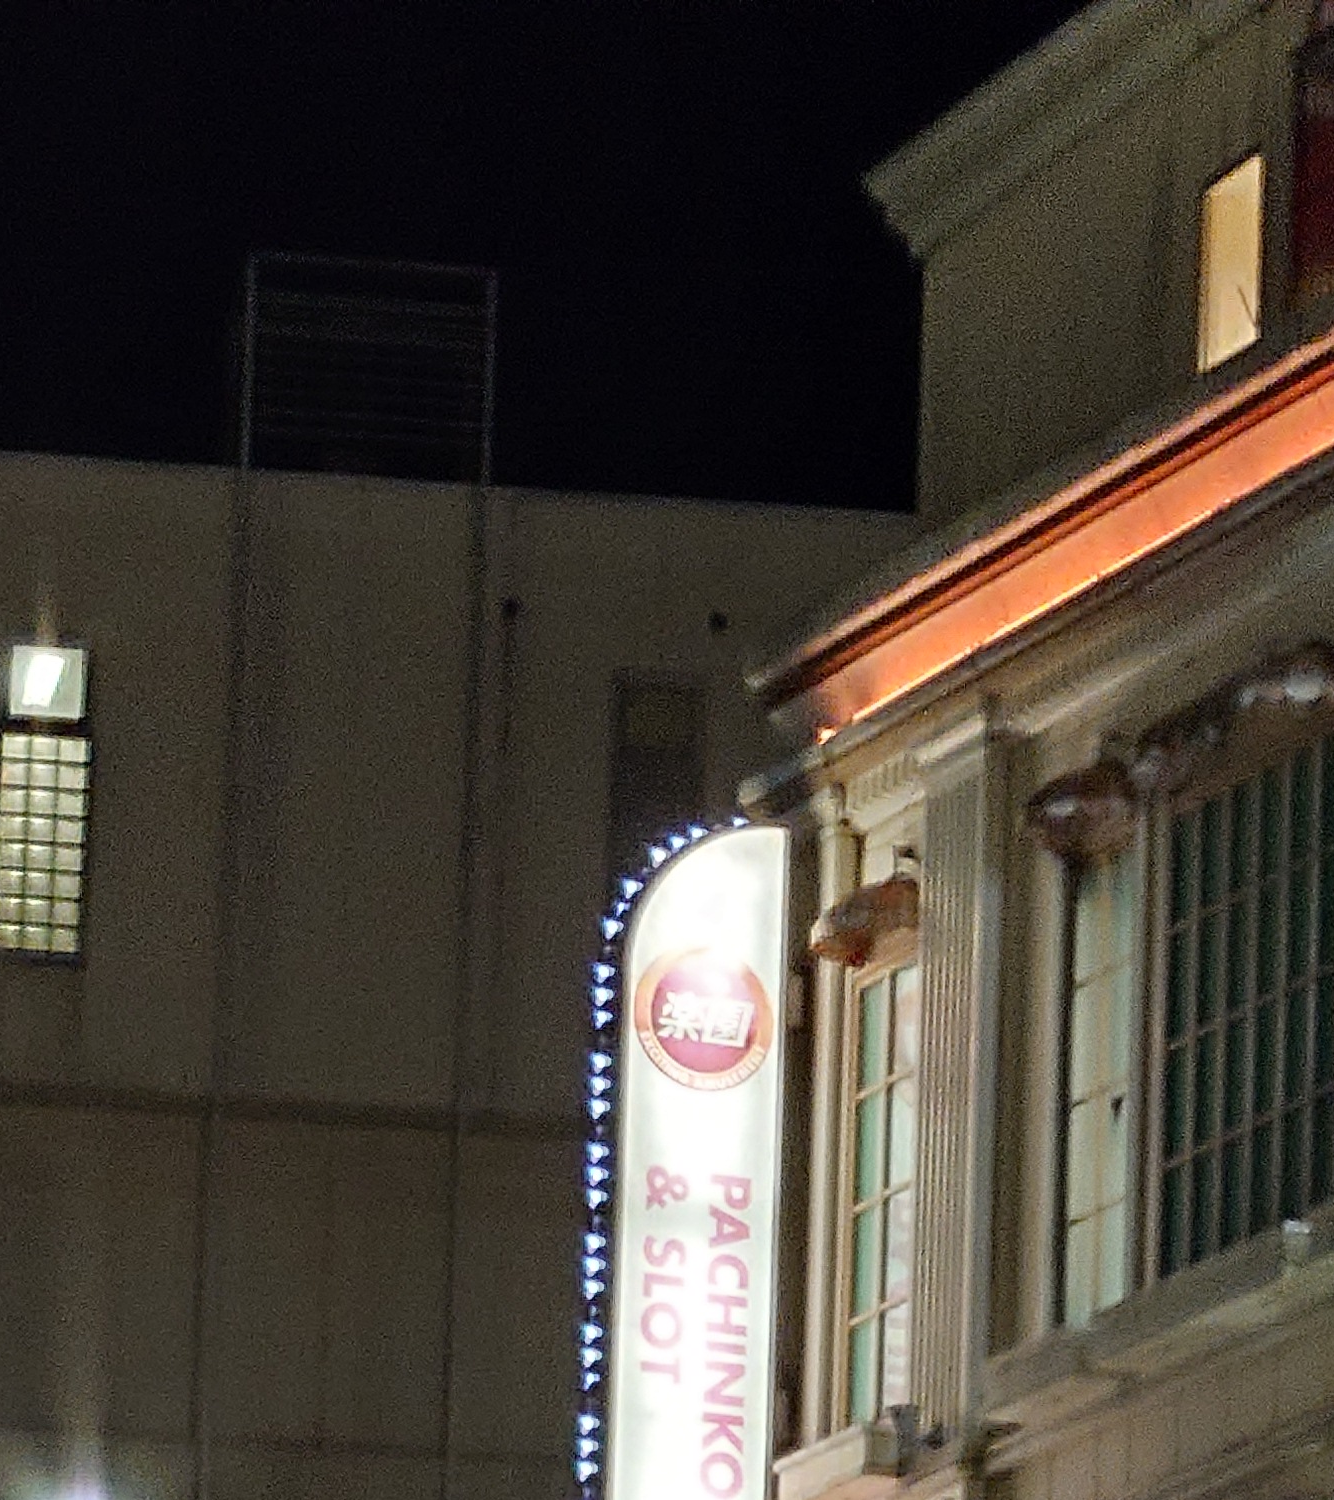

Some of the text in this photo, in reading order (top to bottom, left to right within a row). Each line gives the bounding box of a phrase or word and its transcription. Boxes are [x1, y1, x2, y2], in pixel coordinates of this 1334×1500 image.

[640, 1166, 688, 1383] & SLOT
[700, 1175, 753, 1499] PACHINKO
